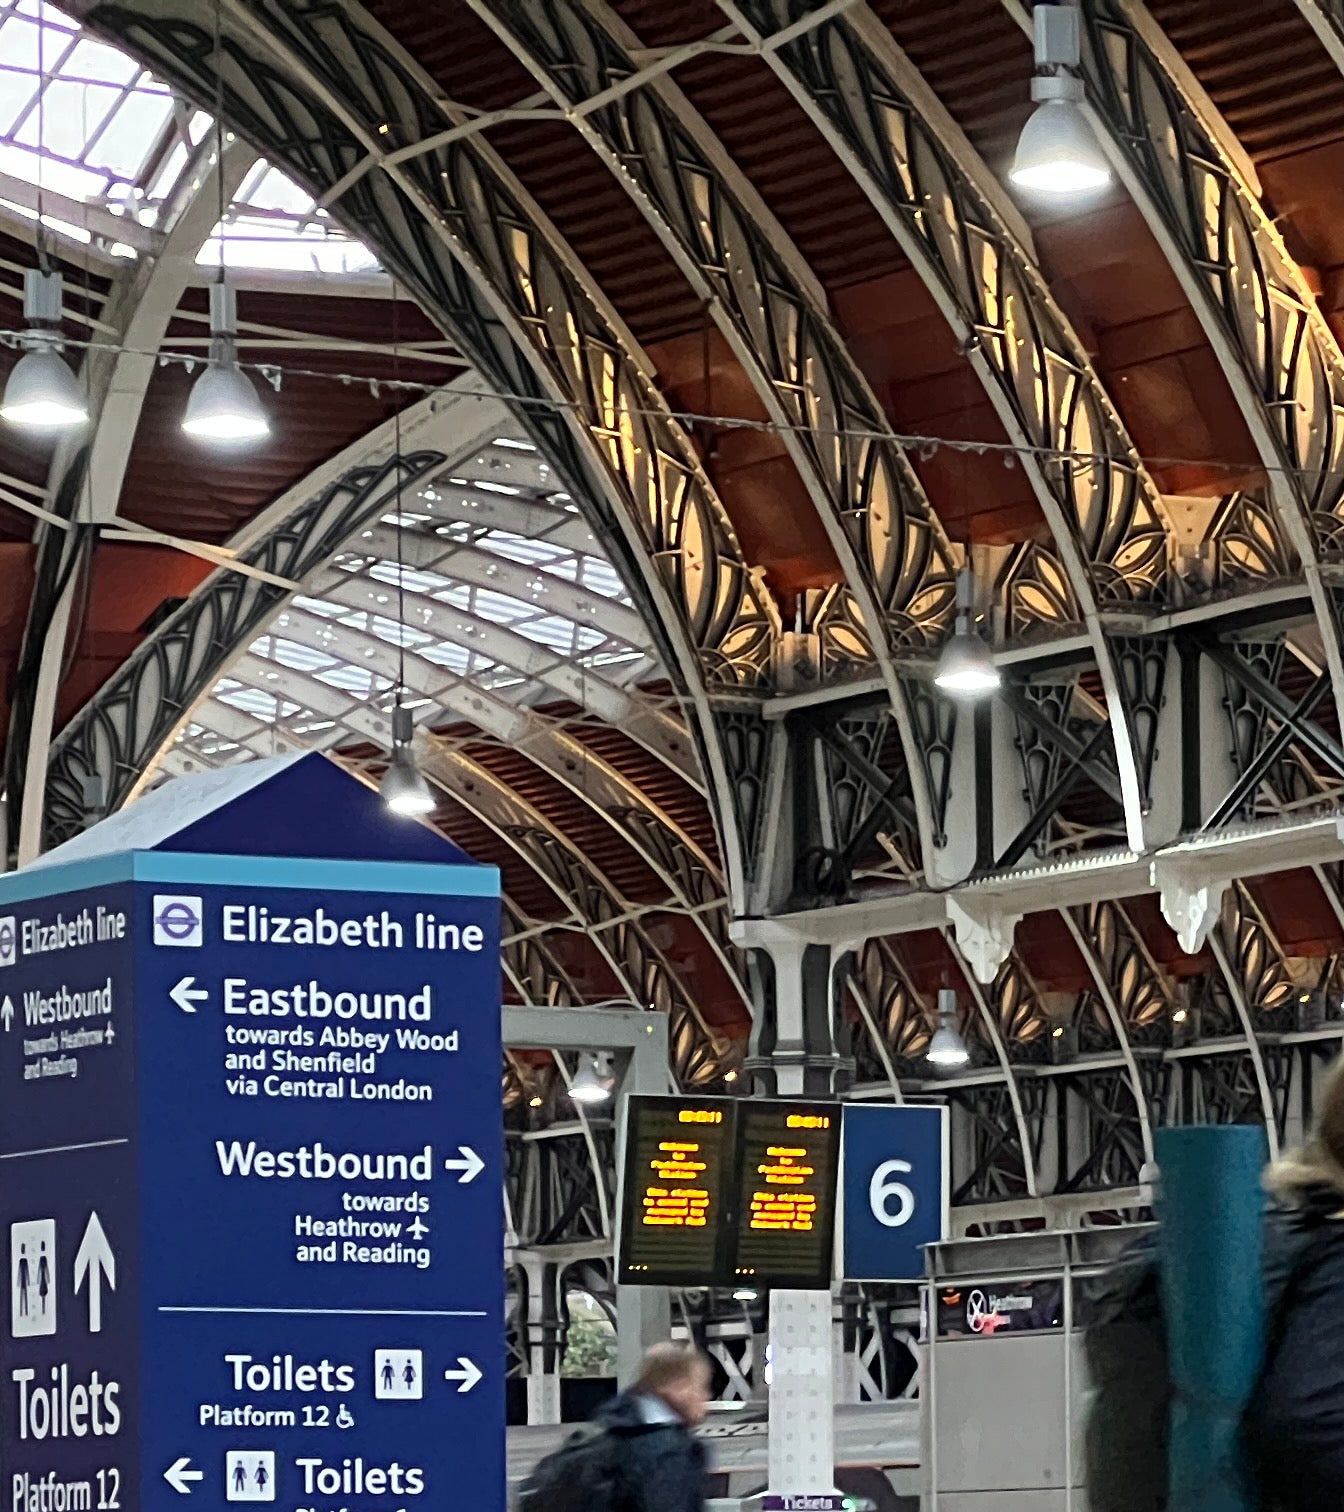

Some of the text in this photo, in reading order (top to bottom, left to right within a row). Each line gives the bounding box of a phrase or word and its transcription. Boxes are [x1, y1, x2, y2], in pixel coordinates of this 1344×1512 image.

[22, 906, 125, 955] Elizabeth line
[223, 905, 484, 951] Elizabeth line
[24, 977, 112, 1026] Westbound
[224, 978, 432, 1021] Eastbound
[225, 1025, 458, 1052] towards Abbey Wood
[225, 1051, 375, 1074] and Shenfield
[226, 1076, 432, 1101] via Central London
[217, 1141, 432, 1180] Westbound
[342, 1192, 430, 1213] towards
[869, 1159, 915, 1228] 6
[295, 1216, 401, 1239] Heathrow
[296, 1242, 431, 1268] and Reading
[225, 1354, 355, 1392] Toilets
[12, 1364, 121, 1440] Toilets
[200, 1405, 329, 1427] Platform 12
[96, 1468, 120, 1510] 12
[296, 1458, 425, 1495] Toilets
